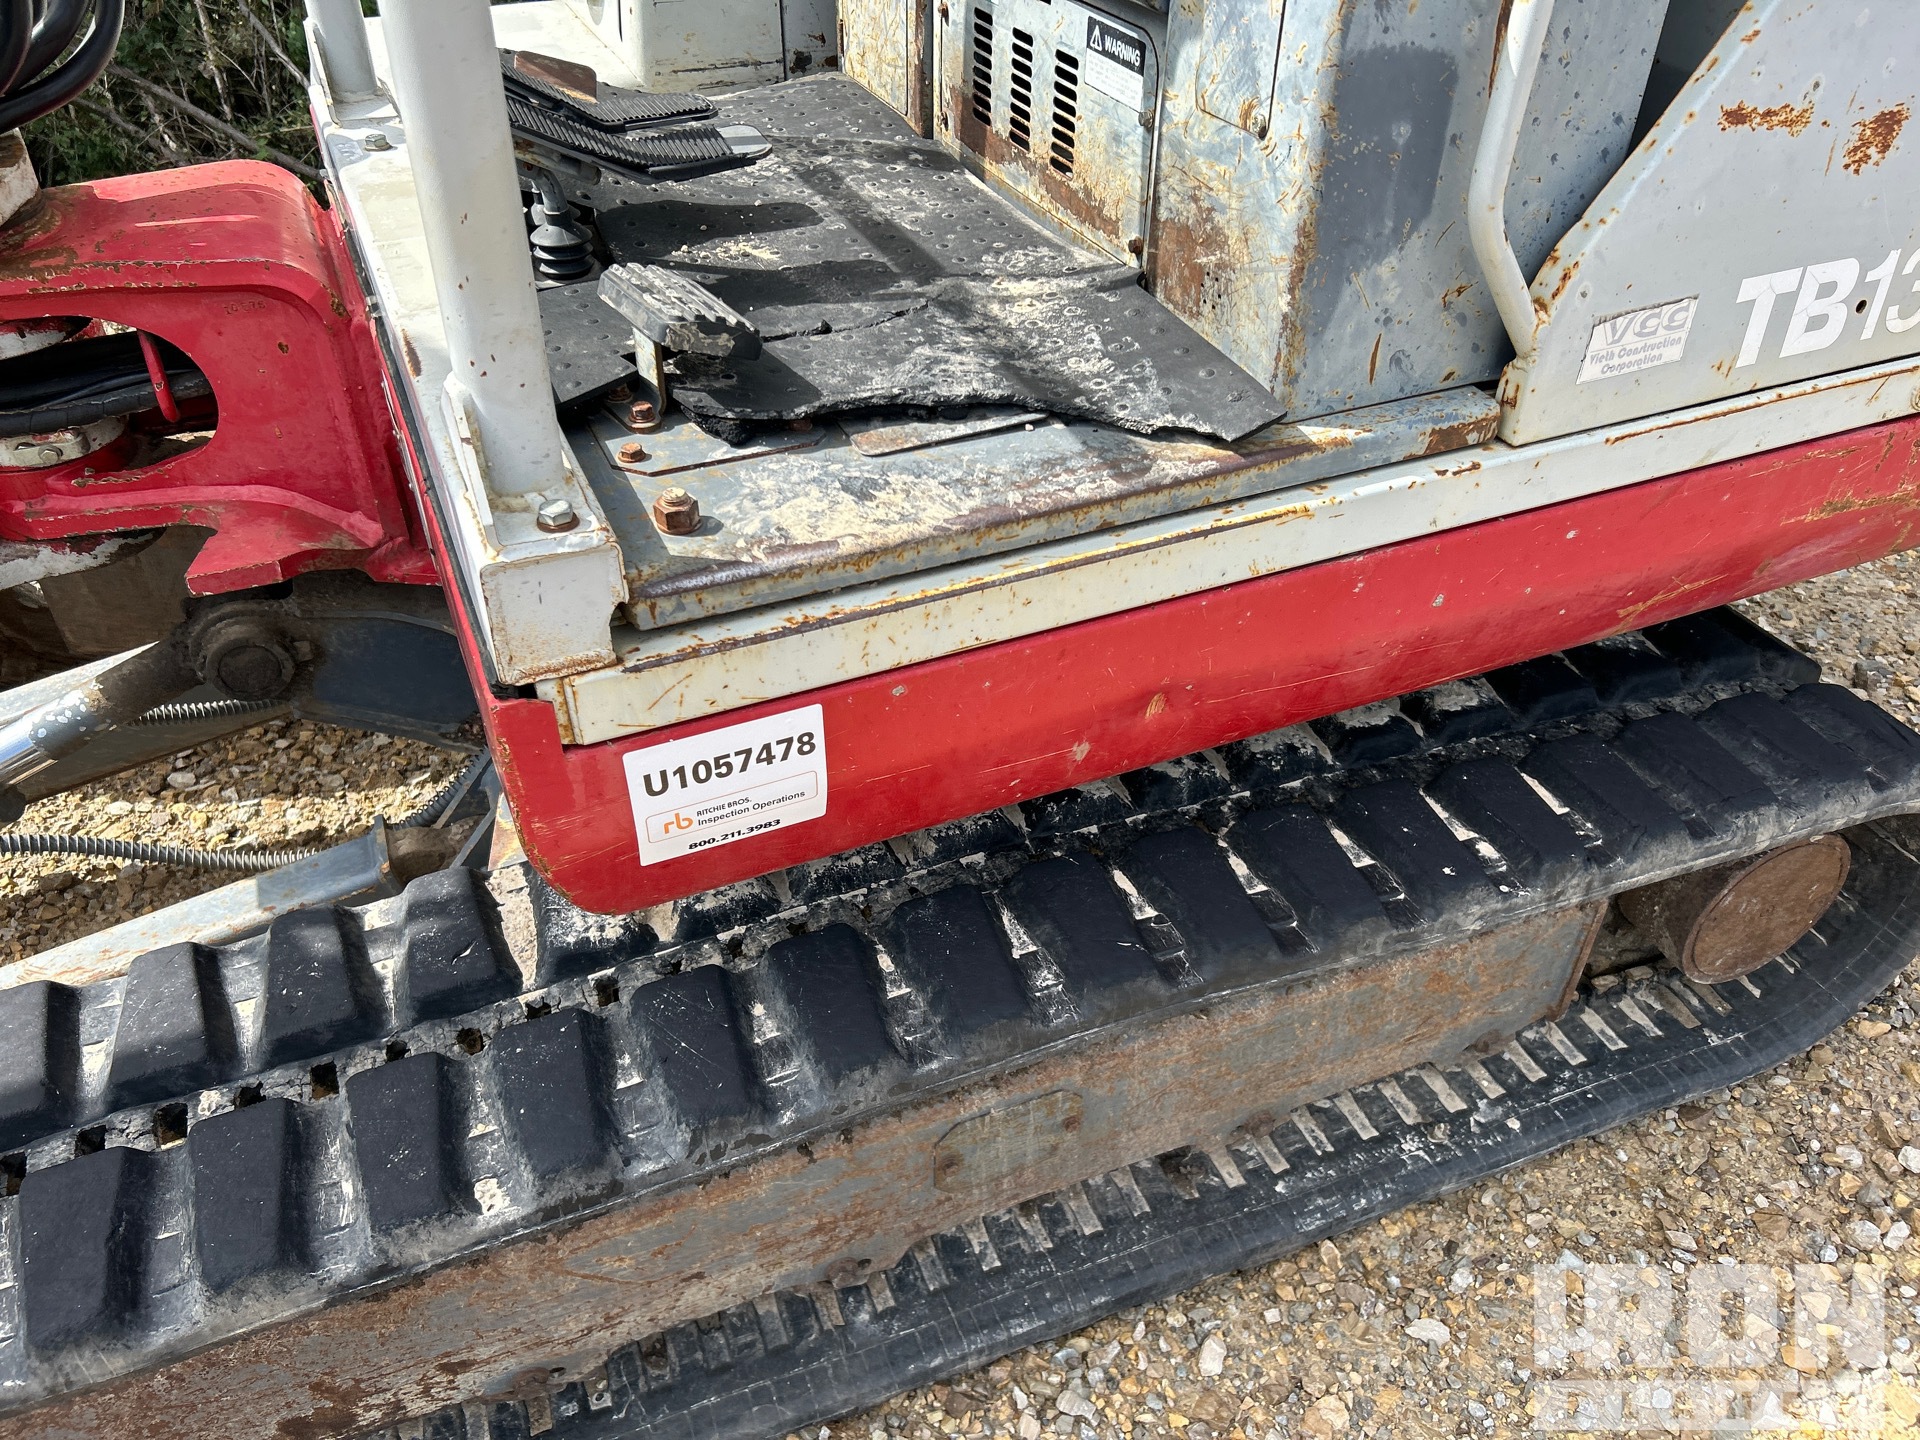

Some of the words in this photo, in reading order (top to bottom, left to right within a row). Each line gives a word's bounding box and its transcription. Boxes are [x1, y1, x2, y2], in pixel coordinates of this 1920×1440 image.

[1104, 34, 1140, 66] WARNING
[1603, 301, 1690, 346] VCC
[1617, 336, 1682, 359] Construction
[1600, 353, 1663, 375] Corporation
[643, 731, 816, 797] U1057478
[696, 803, 726, 817] RITCHIE
[727, 796, 752, 809] BROS.
[698, 806, 750, 826] Inspection
[752, 790, 806, 811] Operations
[664, 812, 694, 834] rb
[688, 818, 781, 850] 800.211.3983
